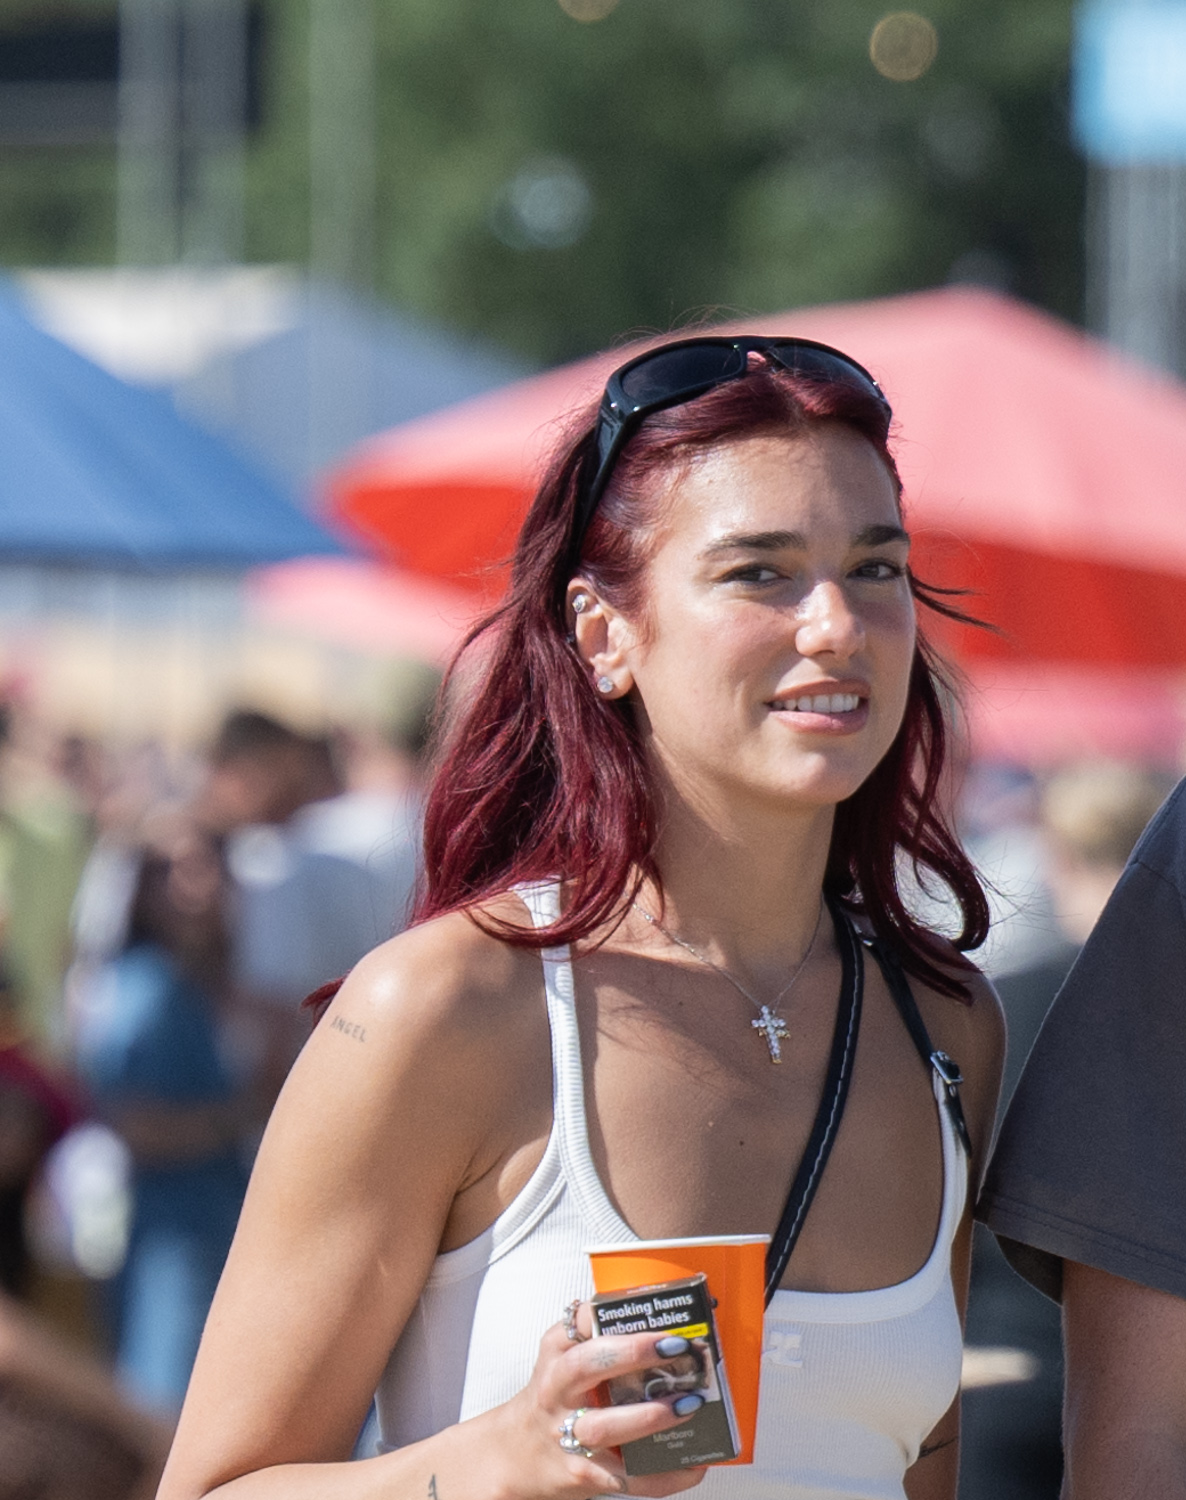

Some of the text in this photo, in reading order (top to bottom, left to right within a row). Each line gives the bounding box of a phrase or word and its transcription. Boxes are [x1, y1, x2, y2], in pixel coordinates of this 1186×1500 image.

[330, 1015, 366, 1043] ANGEL
[598, 1294, 694, 1322] Smoking harms
[602, 1311, 690, 1336] unborn babies
[653, 1429, 695, 1443] Marlboro
